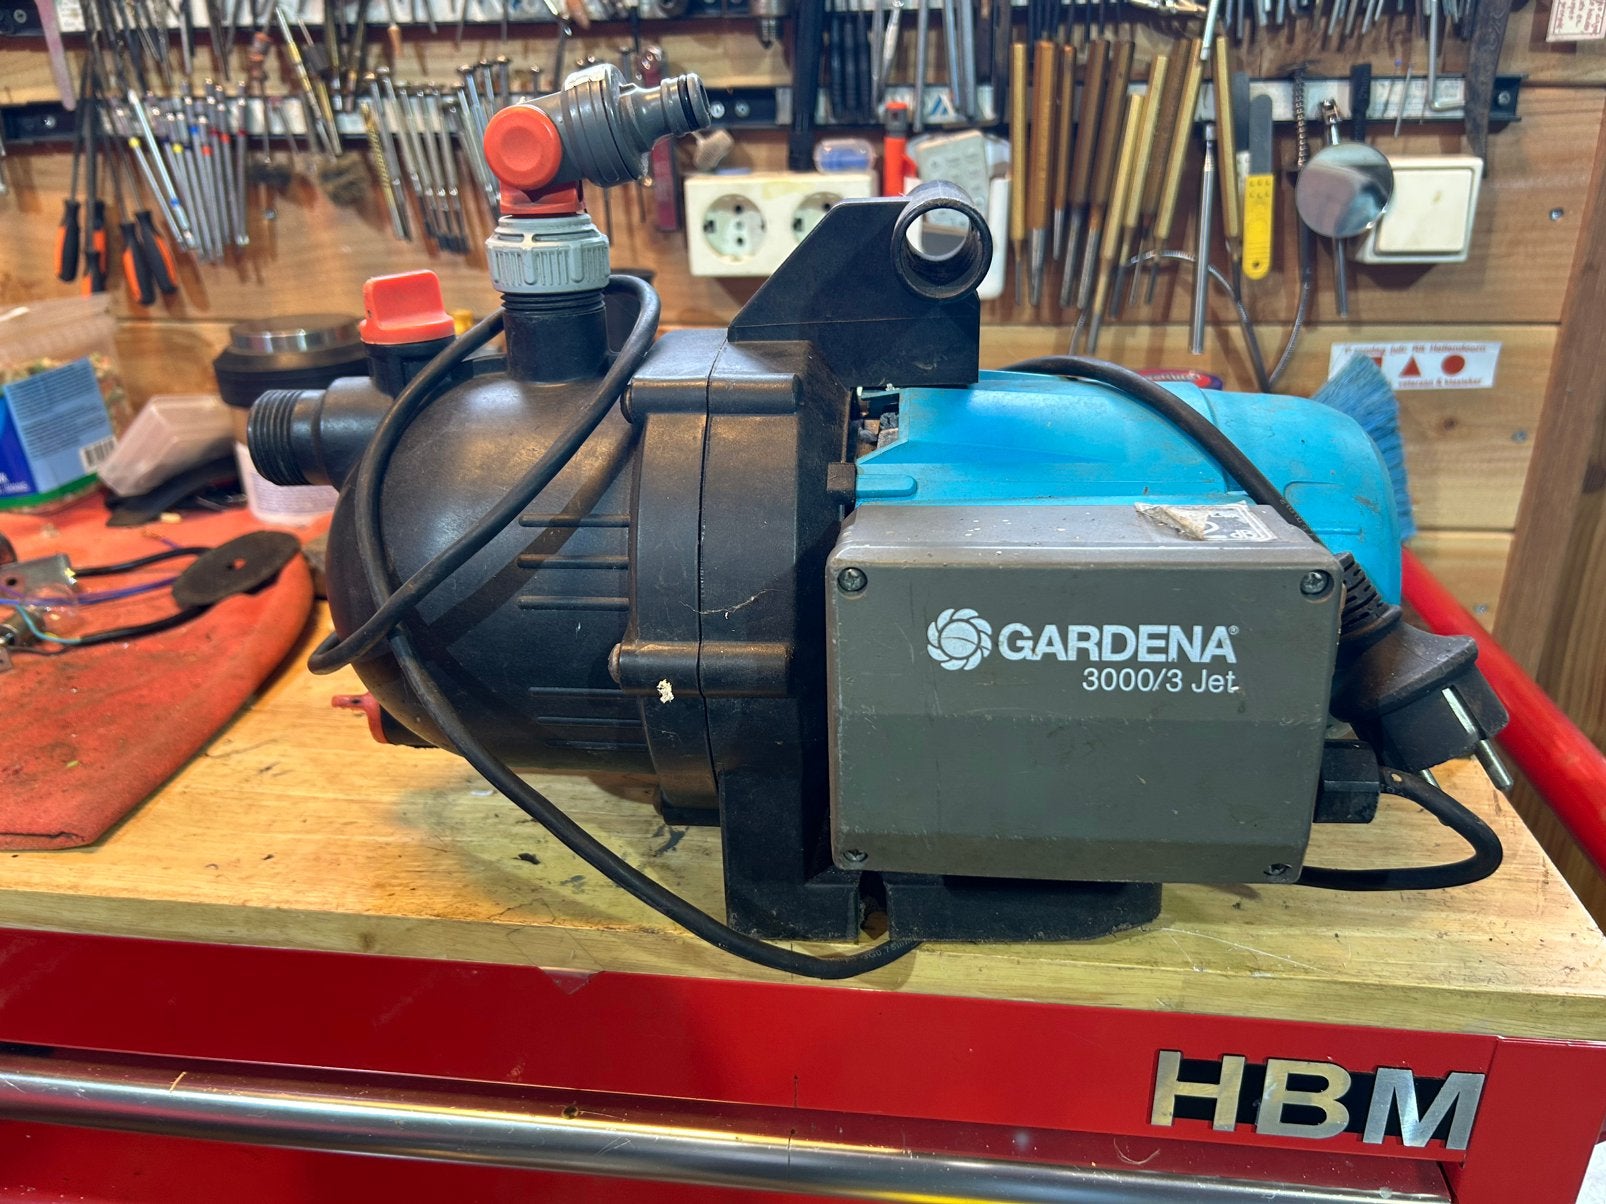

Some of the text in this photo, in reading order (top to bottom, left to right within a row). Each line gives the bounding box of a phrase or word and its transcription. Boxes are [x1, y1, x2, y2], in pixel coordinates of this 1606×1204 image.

[1082, 667, 1237, 693] 3000/3 Jet
[1151, 1050, 1486, 1151] HBM
